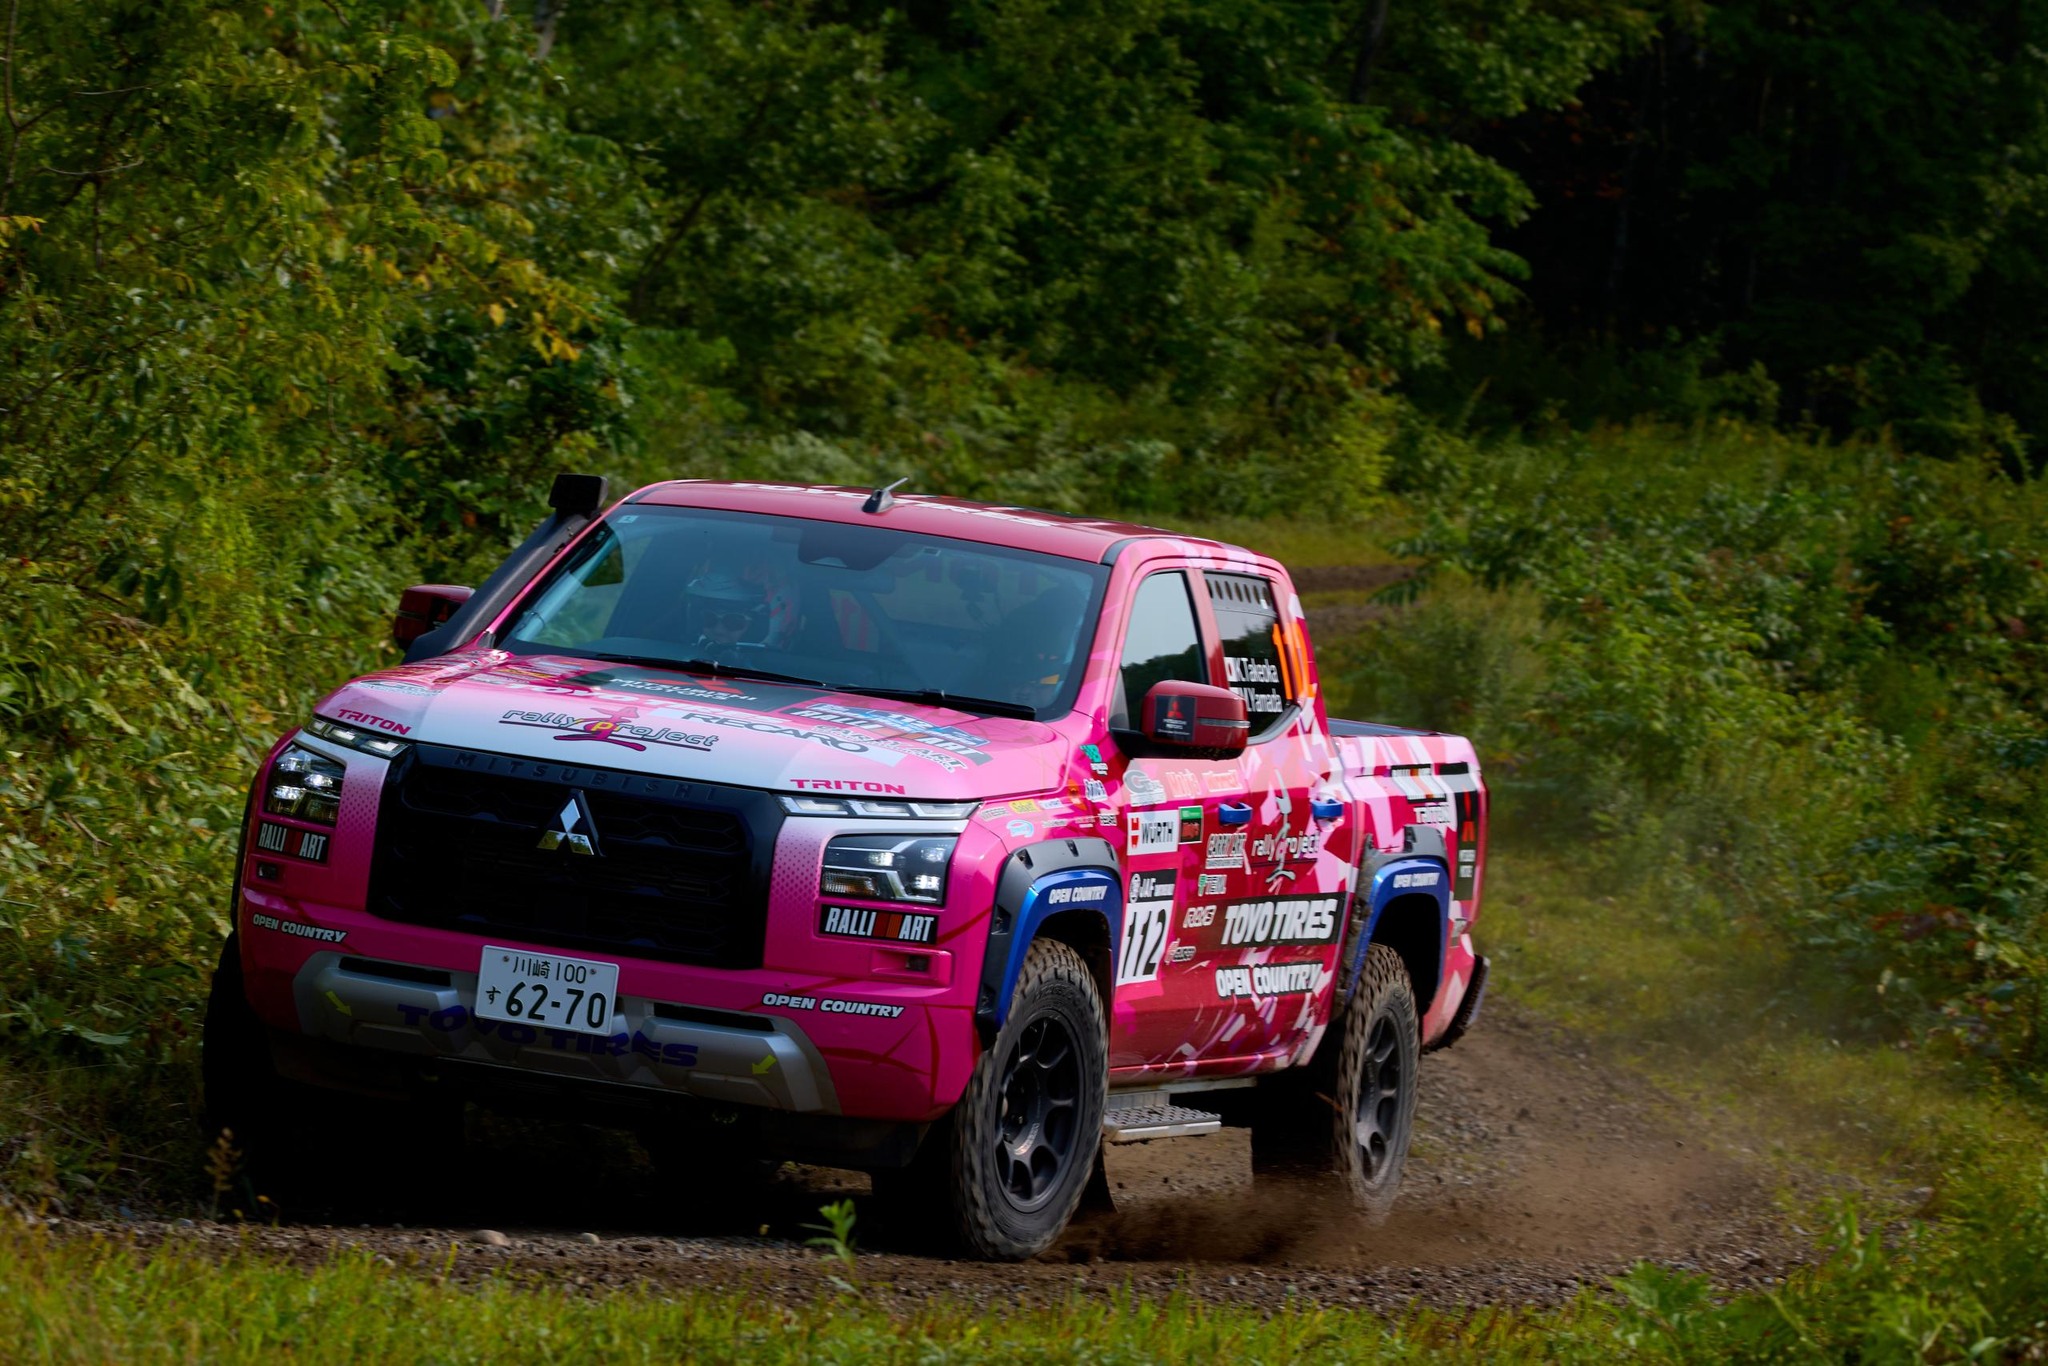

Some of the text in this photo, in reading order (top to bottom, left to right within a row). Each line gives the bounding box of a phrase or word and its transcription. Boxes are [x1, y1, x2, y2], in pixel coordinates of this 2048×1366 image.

[609, 678, 757, 700] MITSUBISHI
[620, 683, 728, 700] MOTORS
[337, 708, 411, 735] TRITON
[502, 707, 719, 747] rally project
[681, 712, 869, 753] RECARO
[454, 752, 717, 801] MITSUBISHI
[790, 779, 905, 795] TRITON
[252, 913, 348, 943] OPEN COUNTRY
[1221, 902, 1275, 945] TOYO
[1270, 899, 1338, 940] TIRES
[1121, 909, 1167, 979] 112
[513, 956, 587, 984] 川崎 100
[1215, 963, 1323, 997] OPEN COUNTRY
[485, 981, 607, 1029] す 62-70
[762, 993, 904, 1018] OPEN COUNTRY
[543, 1026, 698, 1067] TIRES
